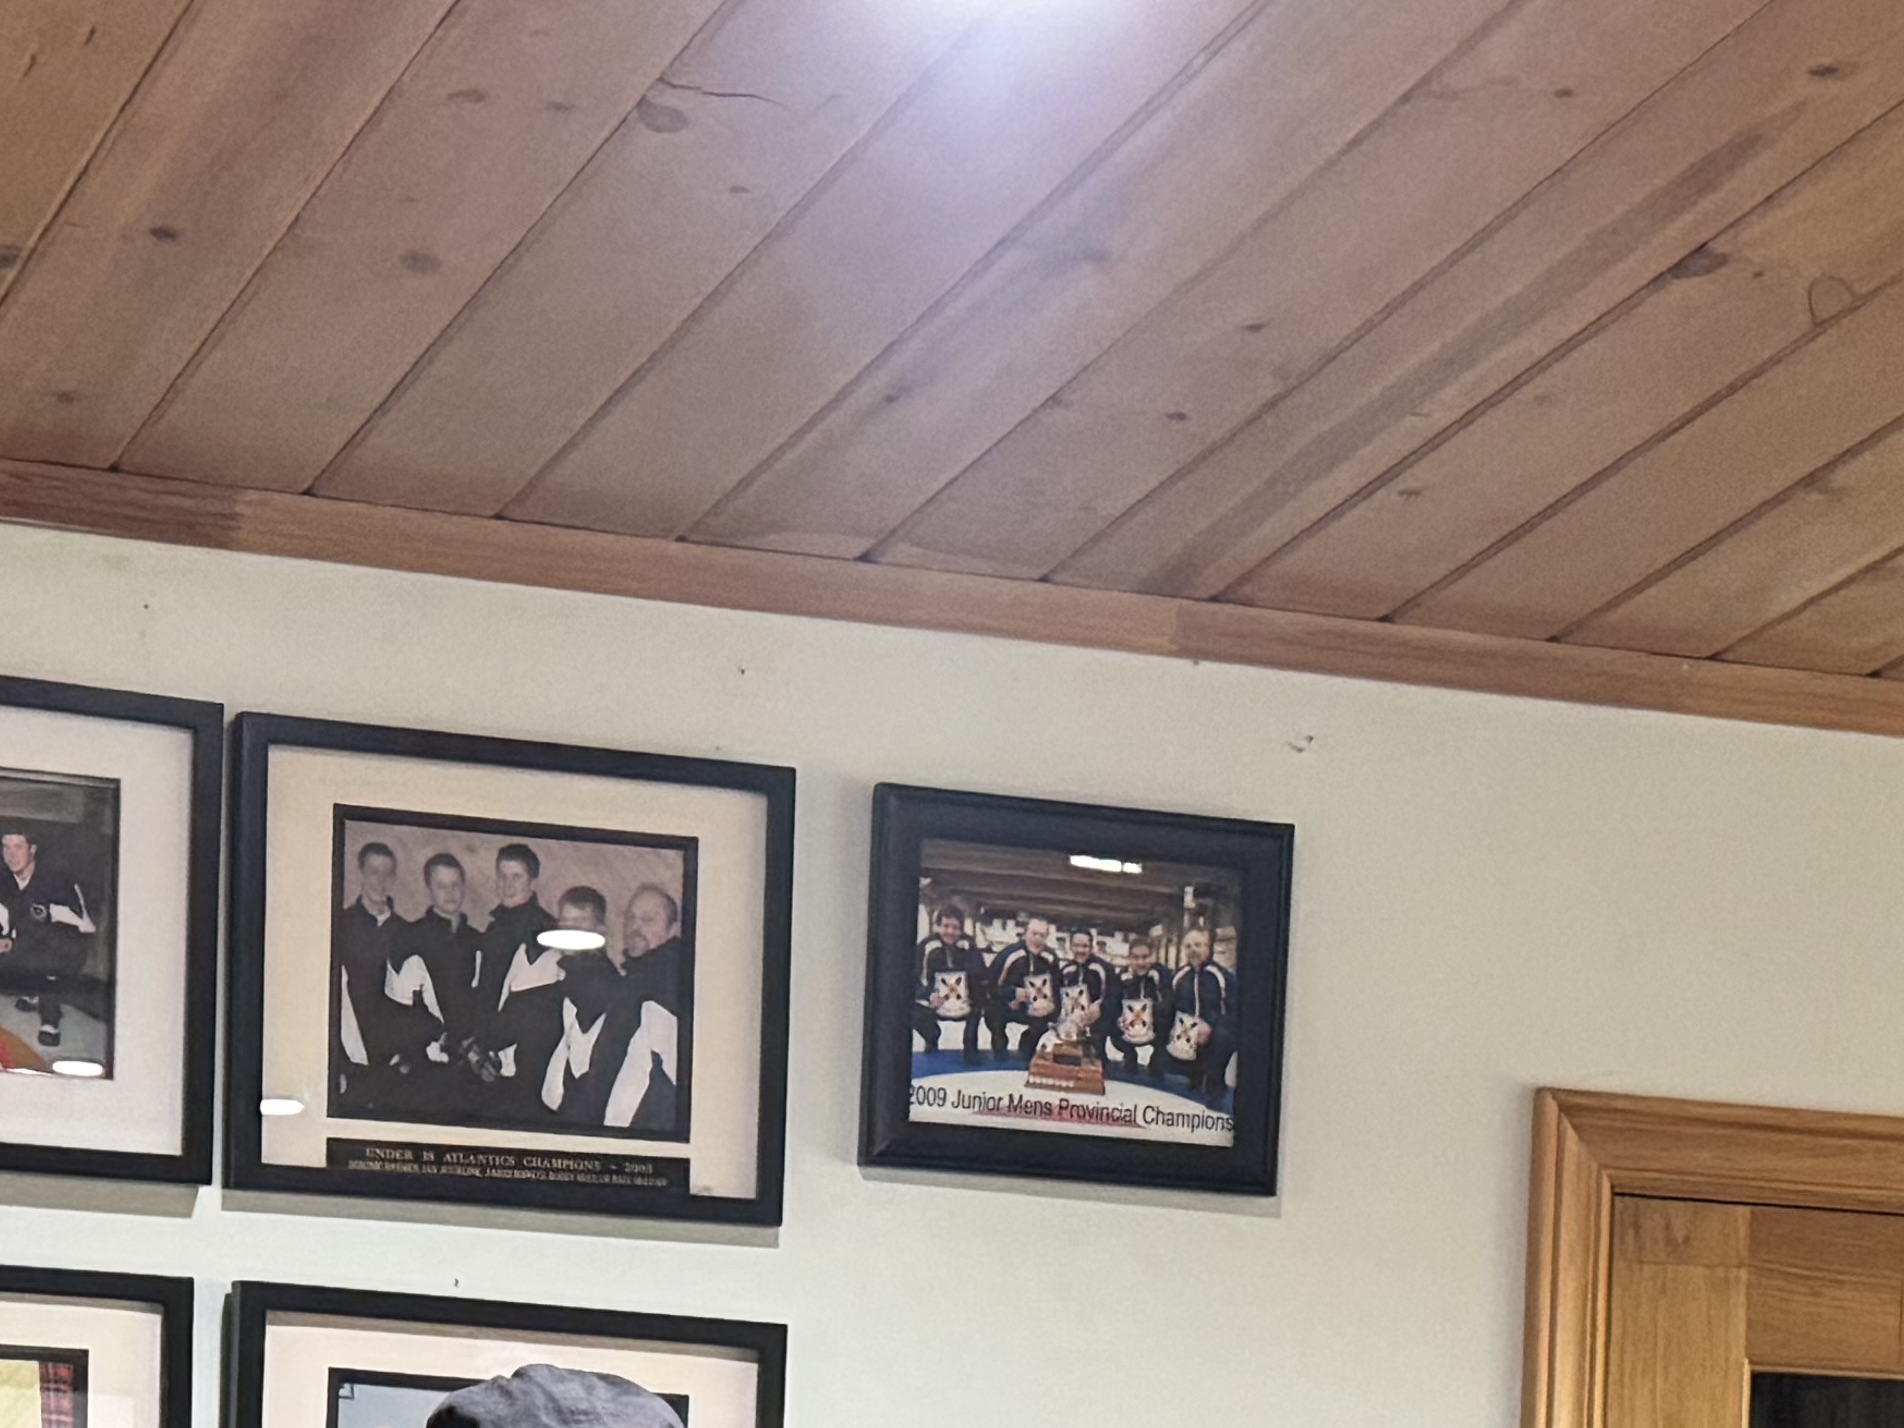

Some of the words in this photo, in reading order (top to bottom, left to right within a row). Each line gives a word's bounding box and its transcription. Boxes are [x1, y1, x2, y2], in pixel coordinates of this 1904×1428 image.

[908, 1085, 947, 1107] 2009
[951, 1091, 1002, 1113] Junior
[1008, 1093, 1053, 1115] Mens
[1058, 1098, 1138, 1124] Provincial
[1142, 1105, 1235, 1133] Champions
[365, 1147, 414, 1160] UNDER
[443, 1152, 515, 1167] ATLANTICS
[523, 1156, 601, 1172] CHAMPIONS
